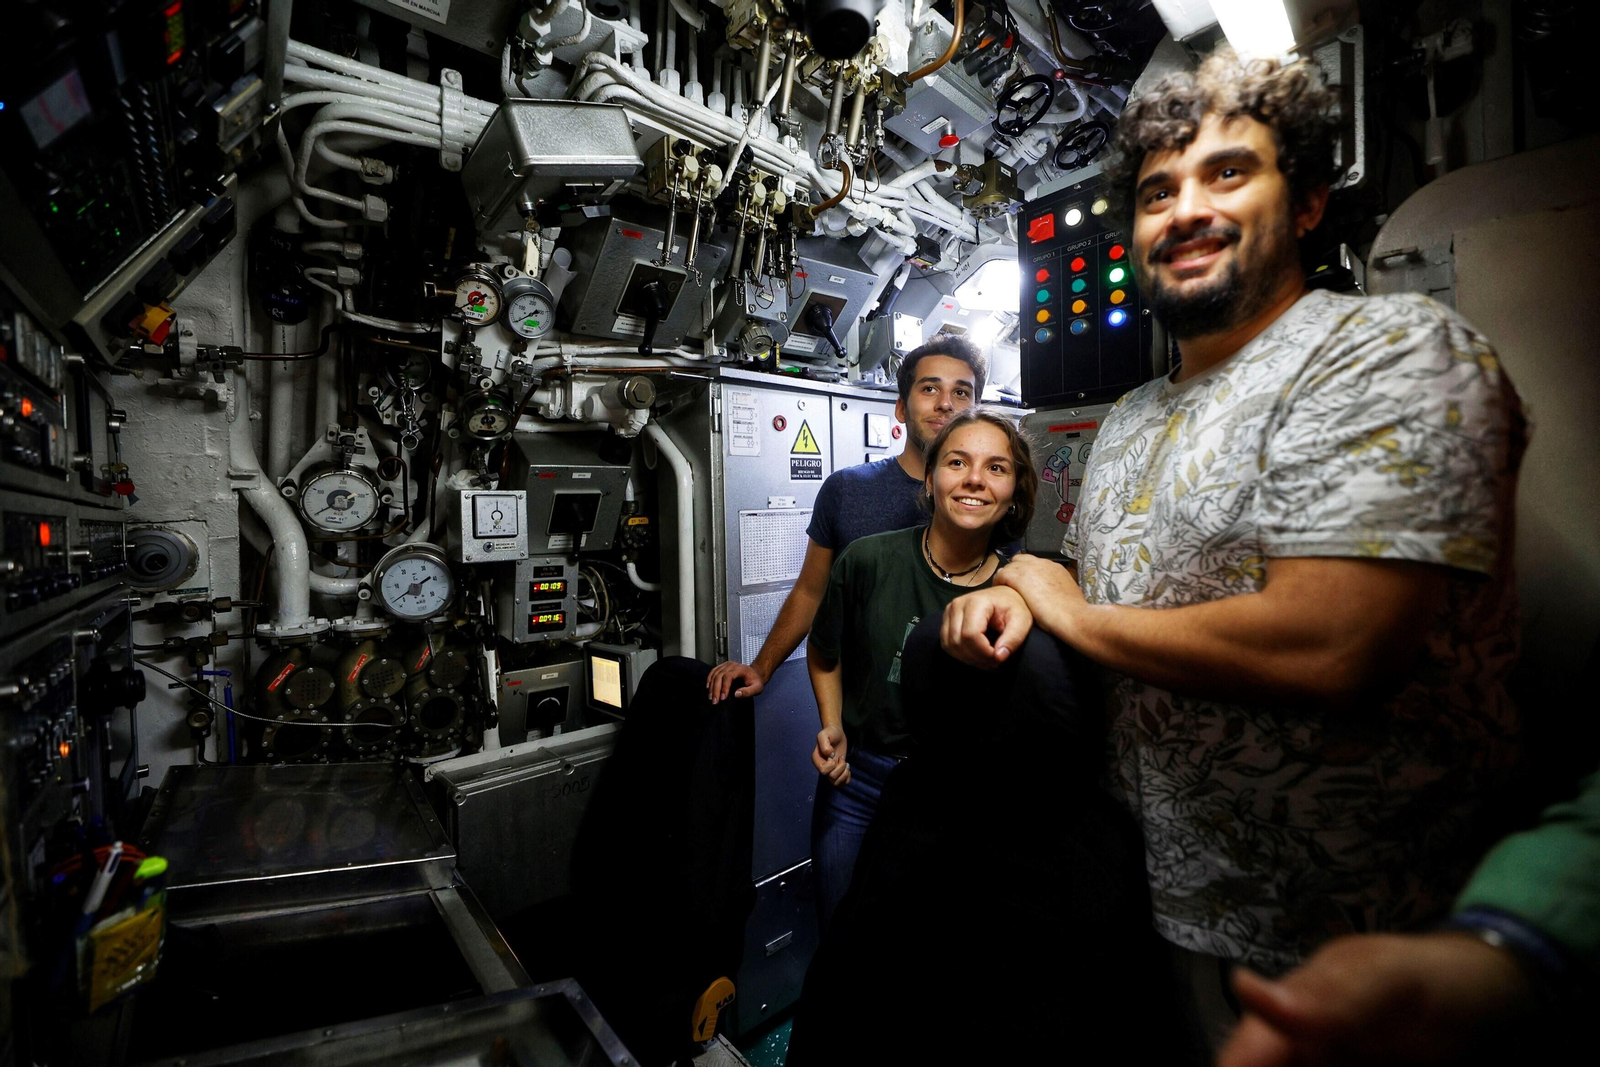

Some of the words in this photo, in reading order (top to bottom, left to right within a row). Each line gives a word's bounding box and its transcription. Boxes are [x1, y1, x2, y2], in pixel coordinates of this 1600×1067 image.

[1067, 241, 1089, 252] GRUPO
[1032, 253, 1053, 264] GRUPO
[791, 459, 822, 467] PELIGRO
[400, 568, 407, 576] 20
[420, 564, 427, 572] 30
[715, 993, 735, 1011] KAB
